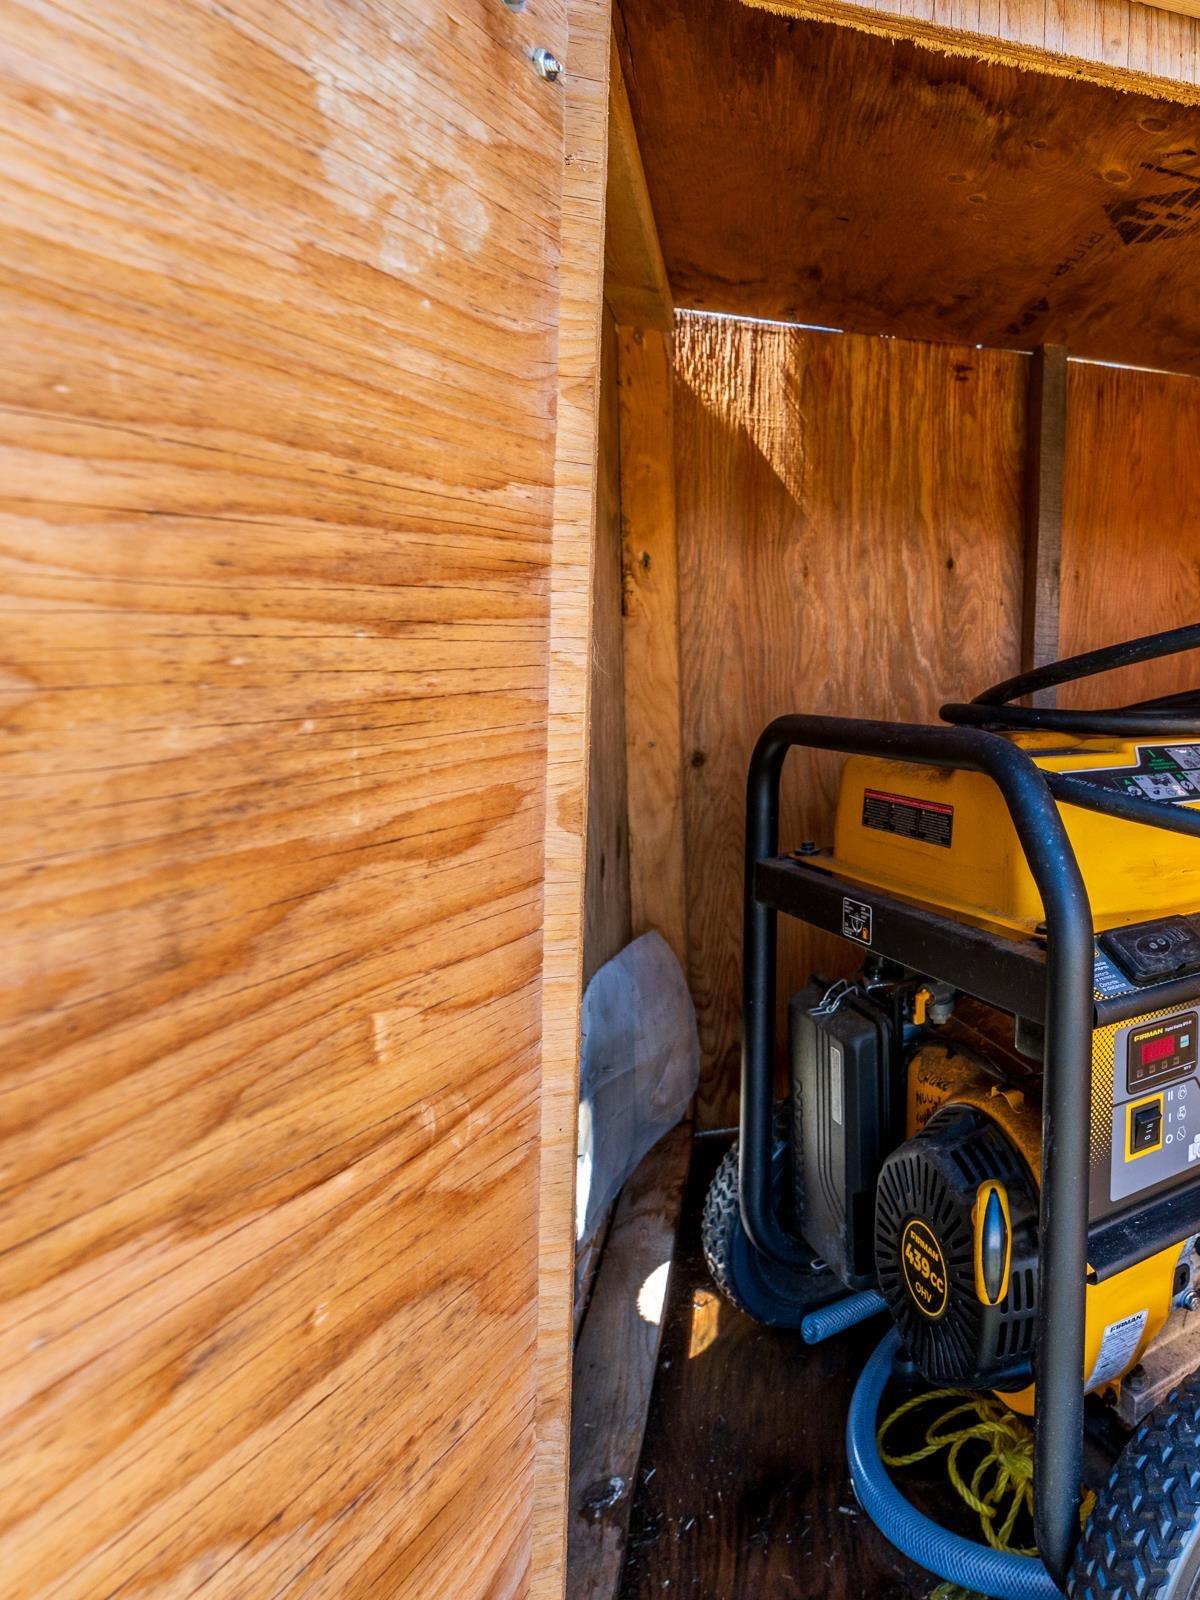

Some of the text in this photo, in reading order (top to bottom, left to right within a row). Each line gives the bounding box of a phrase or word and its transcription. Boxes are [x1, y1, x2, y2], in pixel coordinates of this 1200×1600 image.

[1134, 1027, 1163, 1042] FIRMAN
[911, 1230, 939, 1262] FIRMAN
[915, 1282, 932, 1303] OHV
[1110, 1314, 1142, 1333] FIRMAN
